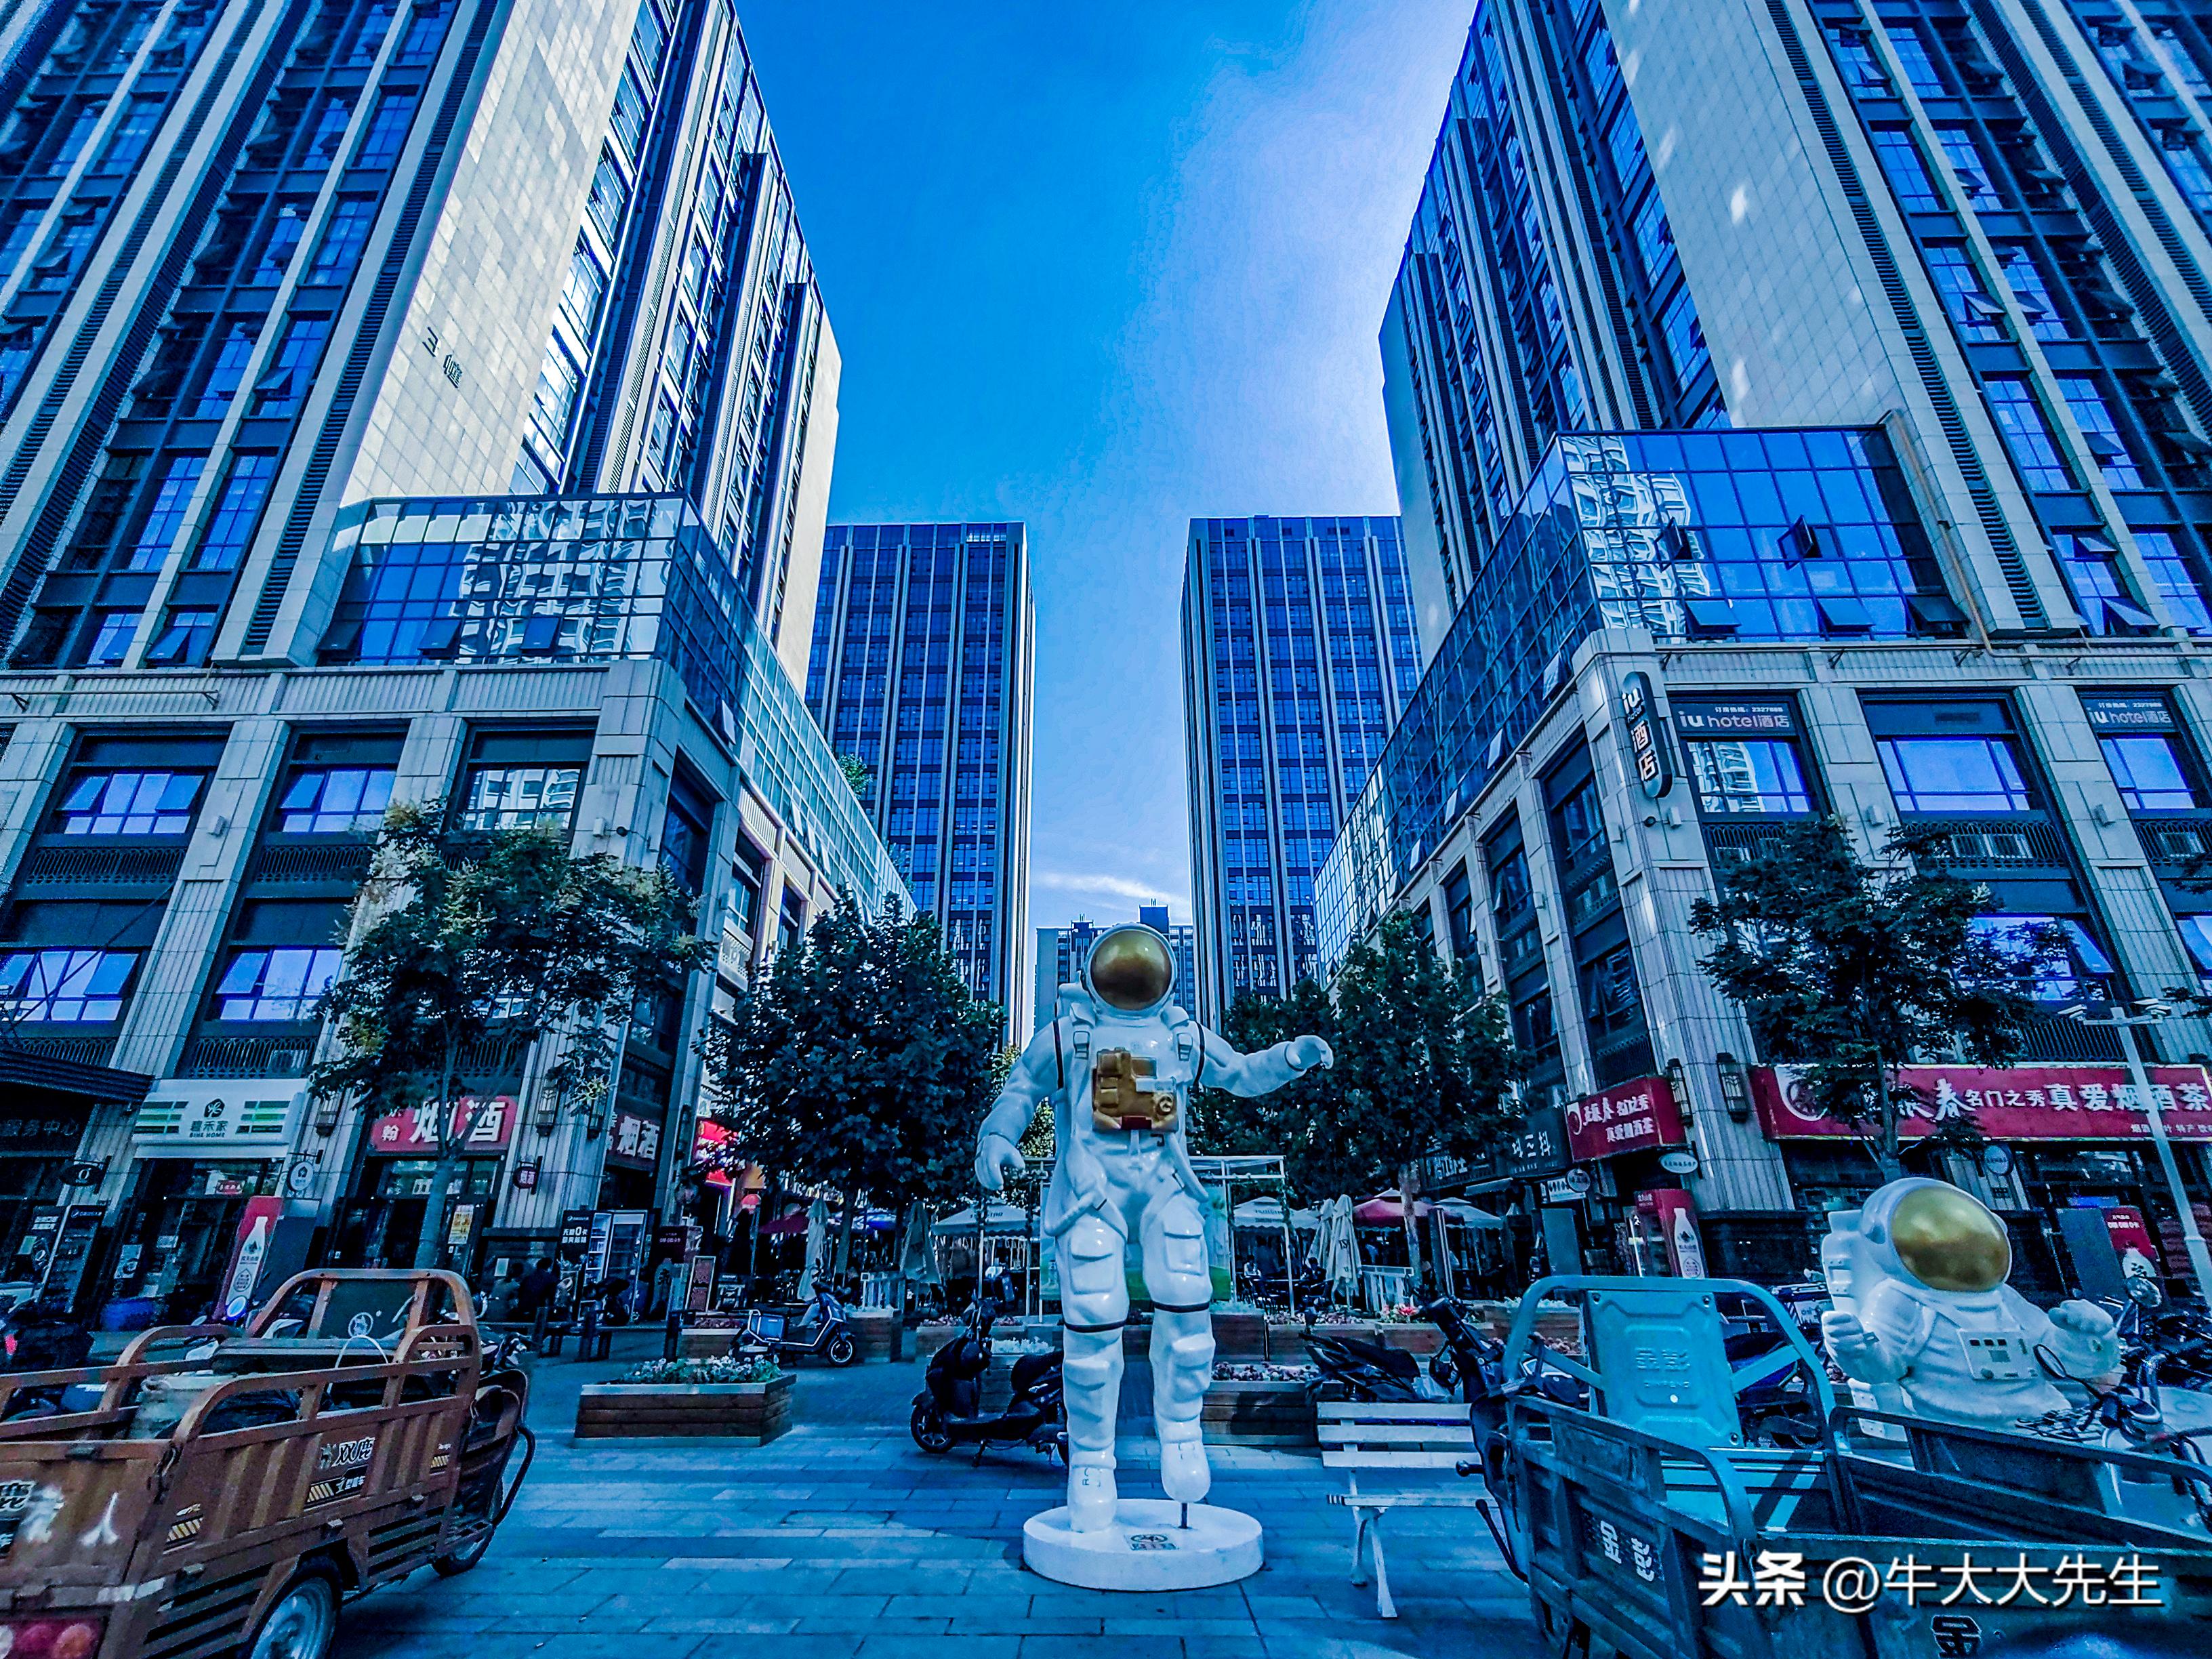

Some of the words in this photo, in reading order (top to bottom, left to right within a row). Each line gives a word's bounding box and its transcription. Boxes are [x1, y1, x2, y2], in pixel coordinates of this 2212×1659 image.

[1622, 688, 1641, 714] iu
[2086, 707, 2109, 724] iu
[1678, 711, 1704, 728] iu
[1631, 720, 1658, 781] 酒店
[2043, 1083, 2212, 1112] 真爱烟酒茶
[409, 1101, 506, 1144] 烟酒
[616, 1115, 661, 1161] 烟酒
